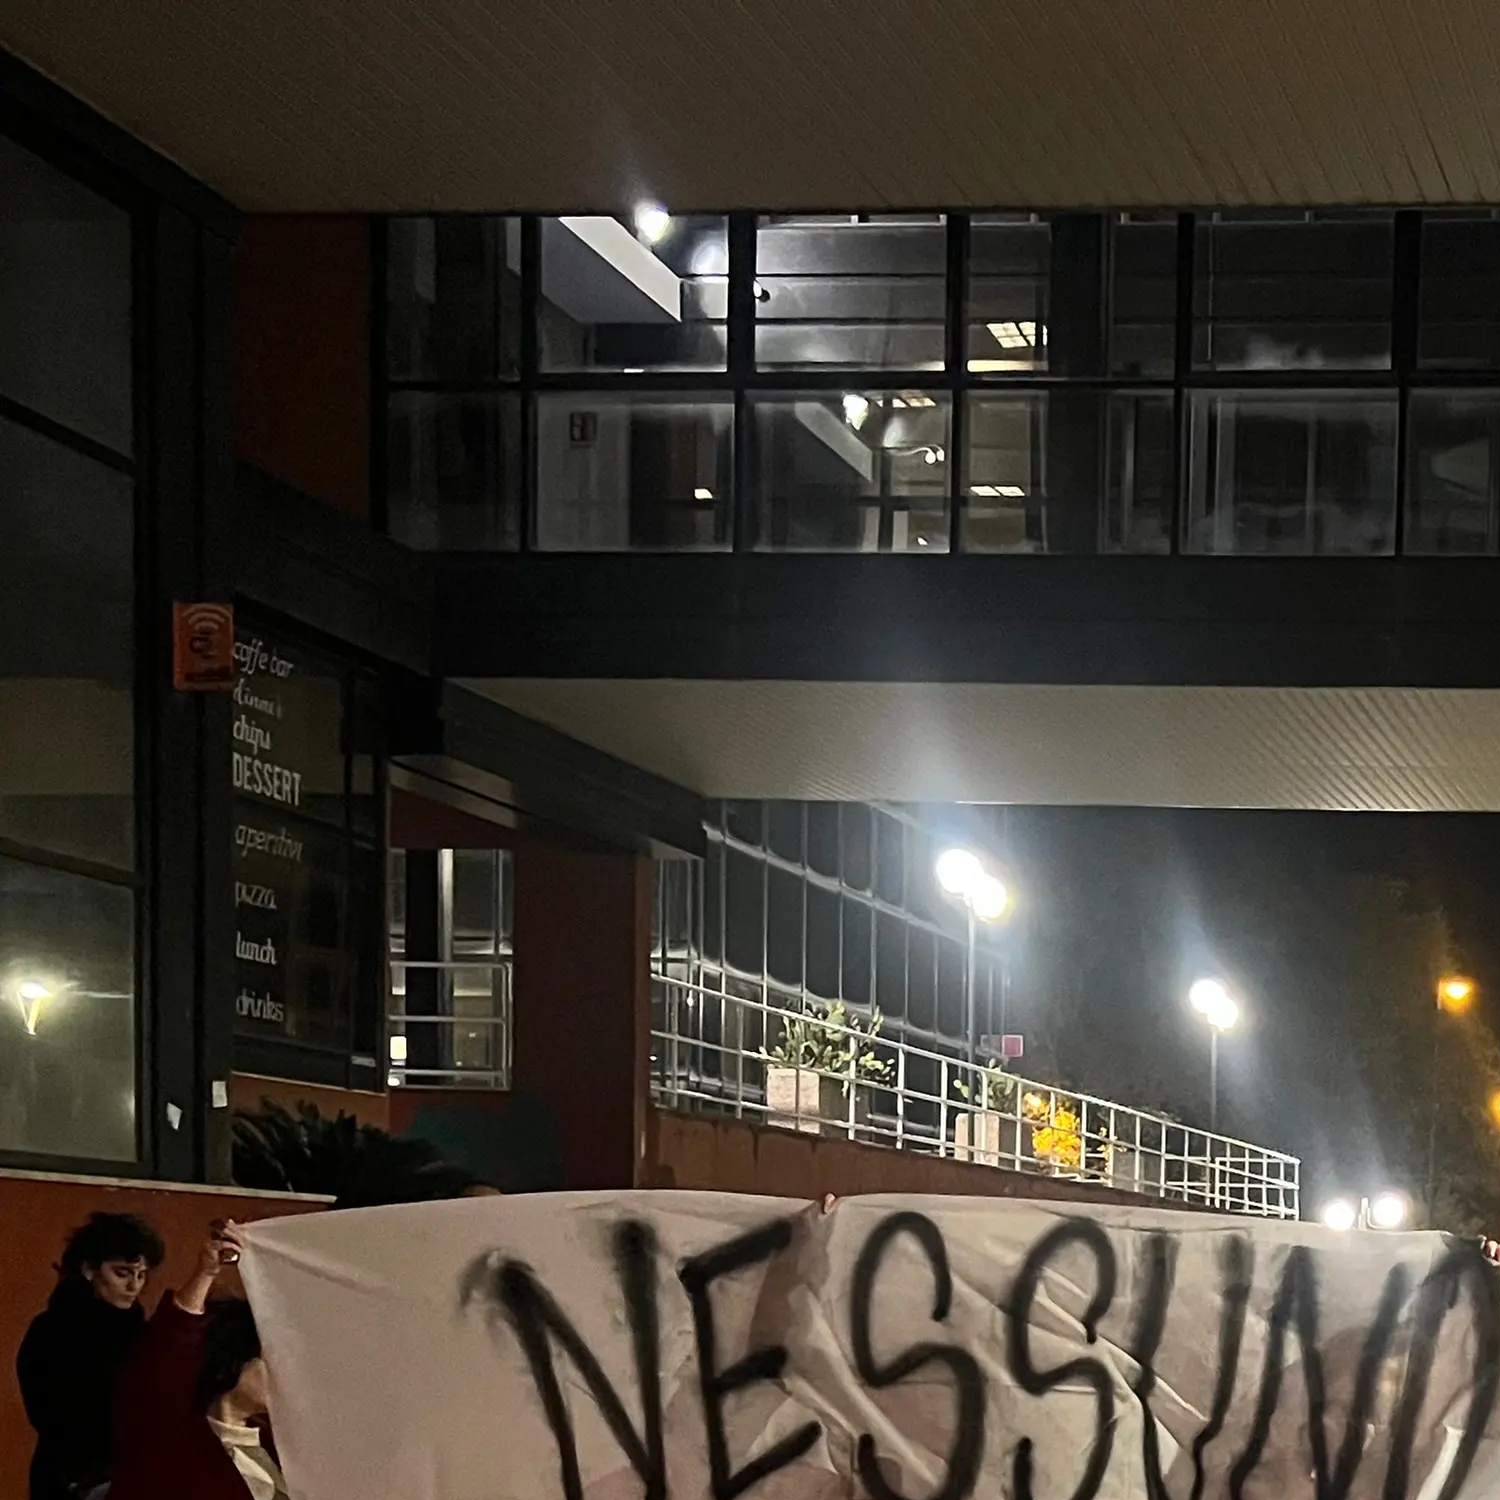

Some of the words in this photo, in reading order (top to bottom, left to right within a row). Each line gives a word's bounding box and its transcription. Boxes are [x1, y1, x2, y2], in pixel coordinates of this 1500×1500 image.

[233, 714, 271, 755] chips
[232, 752, 301, 807] DESSERT
[236, 929, 278, 966] lunch
[236, 987, 285, 1023] drinks
